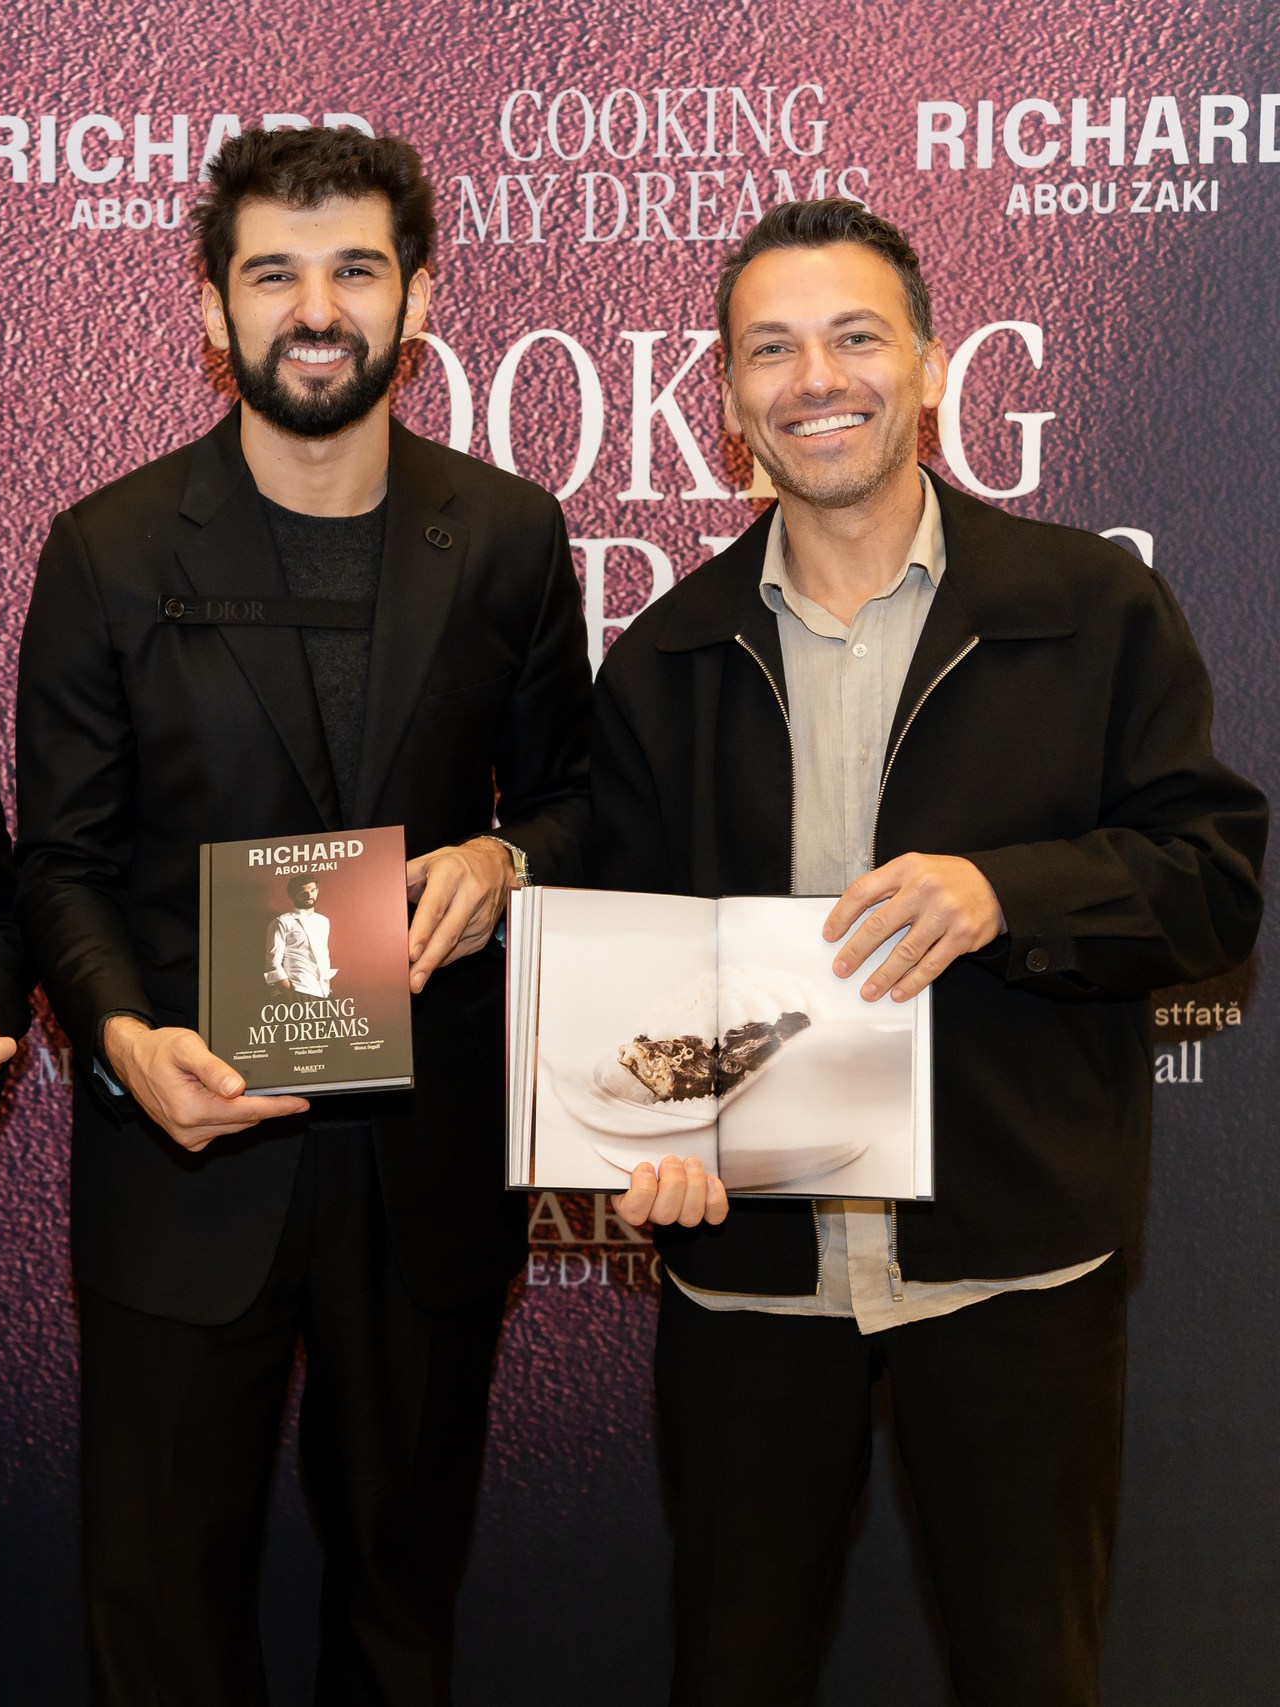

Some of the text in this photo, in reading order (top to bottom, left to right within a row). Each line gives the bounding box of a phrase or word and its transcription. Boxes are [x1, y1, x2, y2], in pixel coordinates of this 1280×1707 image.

[500, 84, 829, 162] COOKING
[916, 93, 1280, 170] RICHAR
[70, 198, 181, 230] ABOU
[454, 173, 560, 246] MY
[1005, 180, 1219, 216] ABOU ZAKI
[206, 600, 264, 621] DIOR
[248, 839, 365, 867] RICHARD
[274, 861, 338, 876] ABOU ZAKI
[261, 997, 356, 1024] COOKING
[1154, 1000, 1242, 1032] stfaţă
[247, 1017, 370, 1046] MY DREAMS
[293, 1064, 326, 1072] MARETTI
[1154, 1040, 1204, 1084] all
[526, 1251, 662, 1286] EDIT
